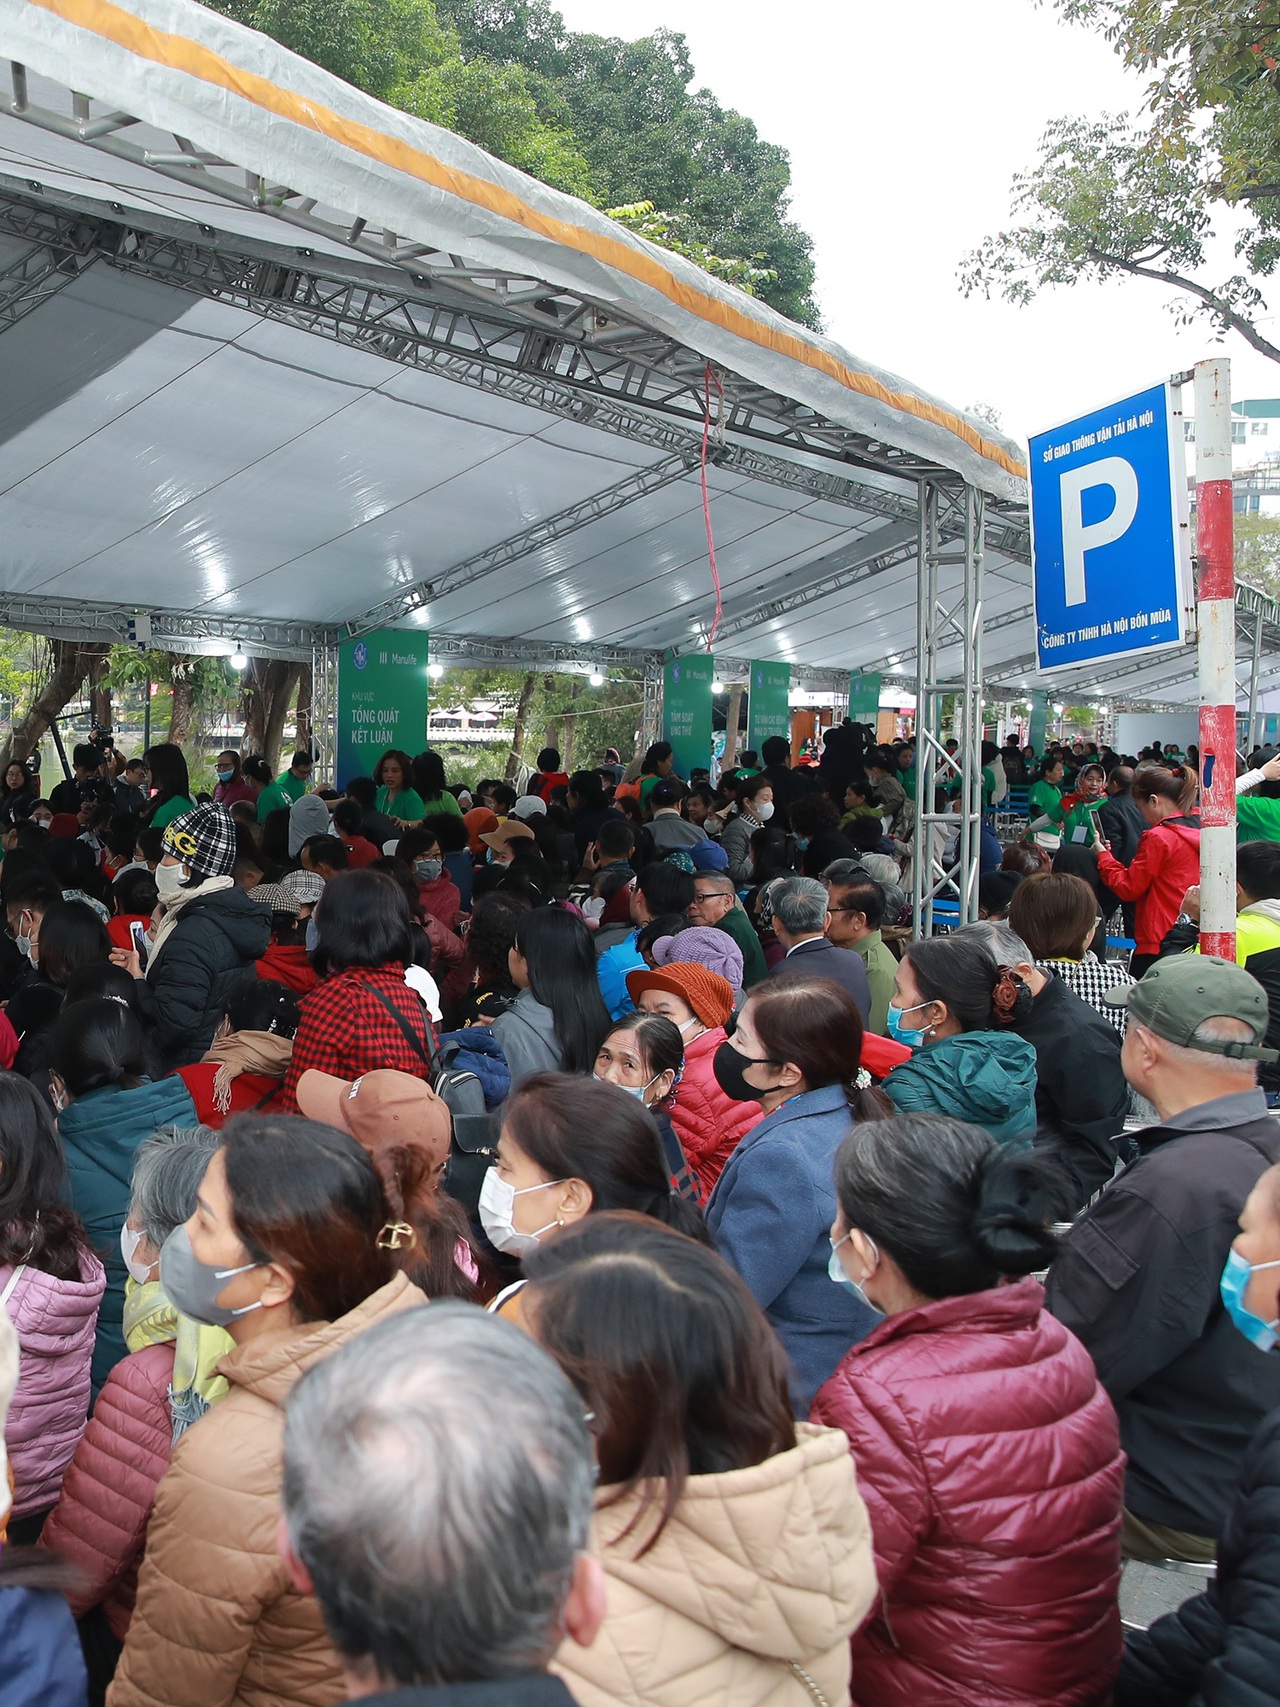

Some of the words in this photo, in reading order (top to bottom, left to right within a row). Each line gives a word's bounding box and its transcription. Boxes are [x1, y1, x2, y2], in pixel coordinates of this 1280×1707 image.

[1043, 444, 1053, 463] SỞ
[1054, 442, 1071, 459] GIAO
[1071, 433, 1096, 453] THÔNG
[1096, 426, 1112, 444] VẬN
[1113, 417, 1125, 437] TẢI
[1126, 414, 1138, 433] HÀ
[1139, 409, 1154, 428] NỘI
[1060, 456, 1139, 608] P
[1043, 633, 1065, 649] CÔNG
[1066, 631, 1076, 644] TY
[1078, 626, 1099, 642] TNHH
[1100, 620, 1112, 636] HÀ
[1113, 616, 1128, 635] NỘI
[1130, 610, 1148, 630] BỐN
[1150, 607, 1172, 626] MÙA
[392, 653, 417, 665] Manulife
[351, 704, 376, 723] TỔNG
[377, 707, 400, 726] QUÁT
[351, 725, 369, 744] KẾT
[370, 726, 393, 746] LUẬN
